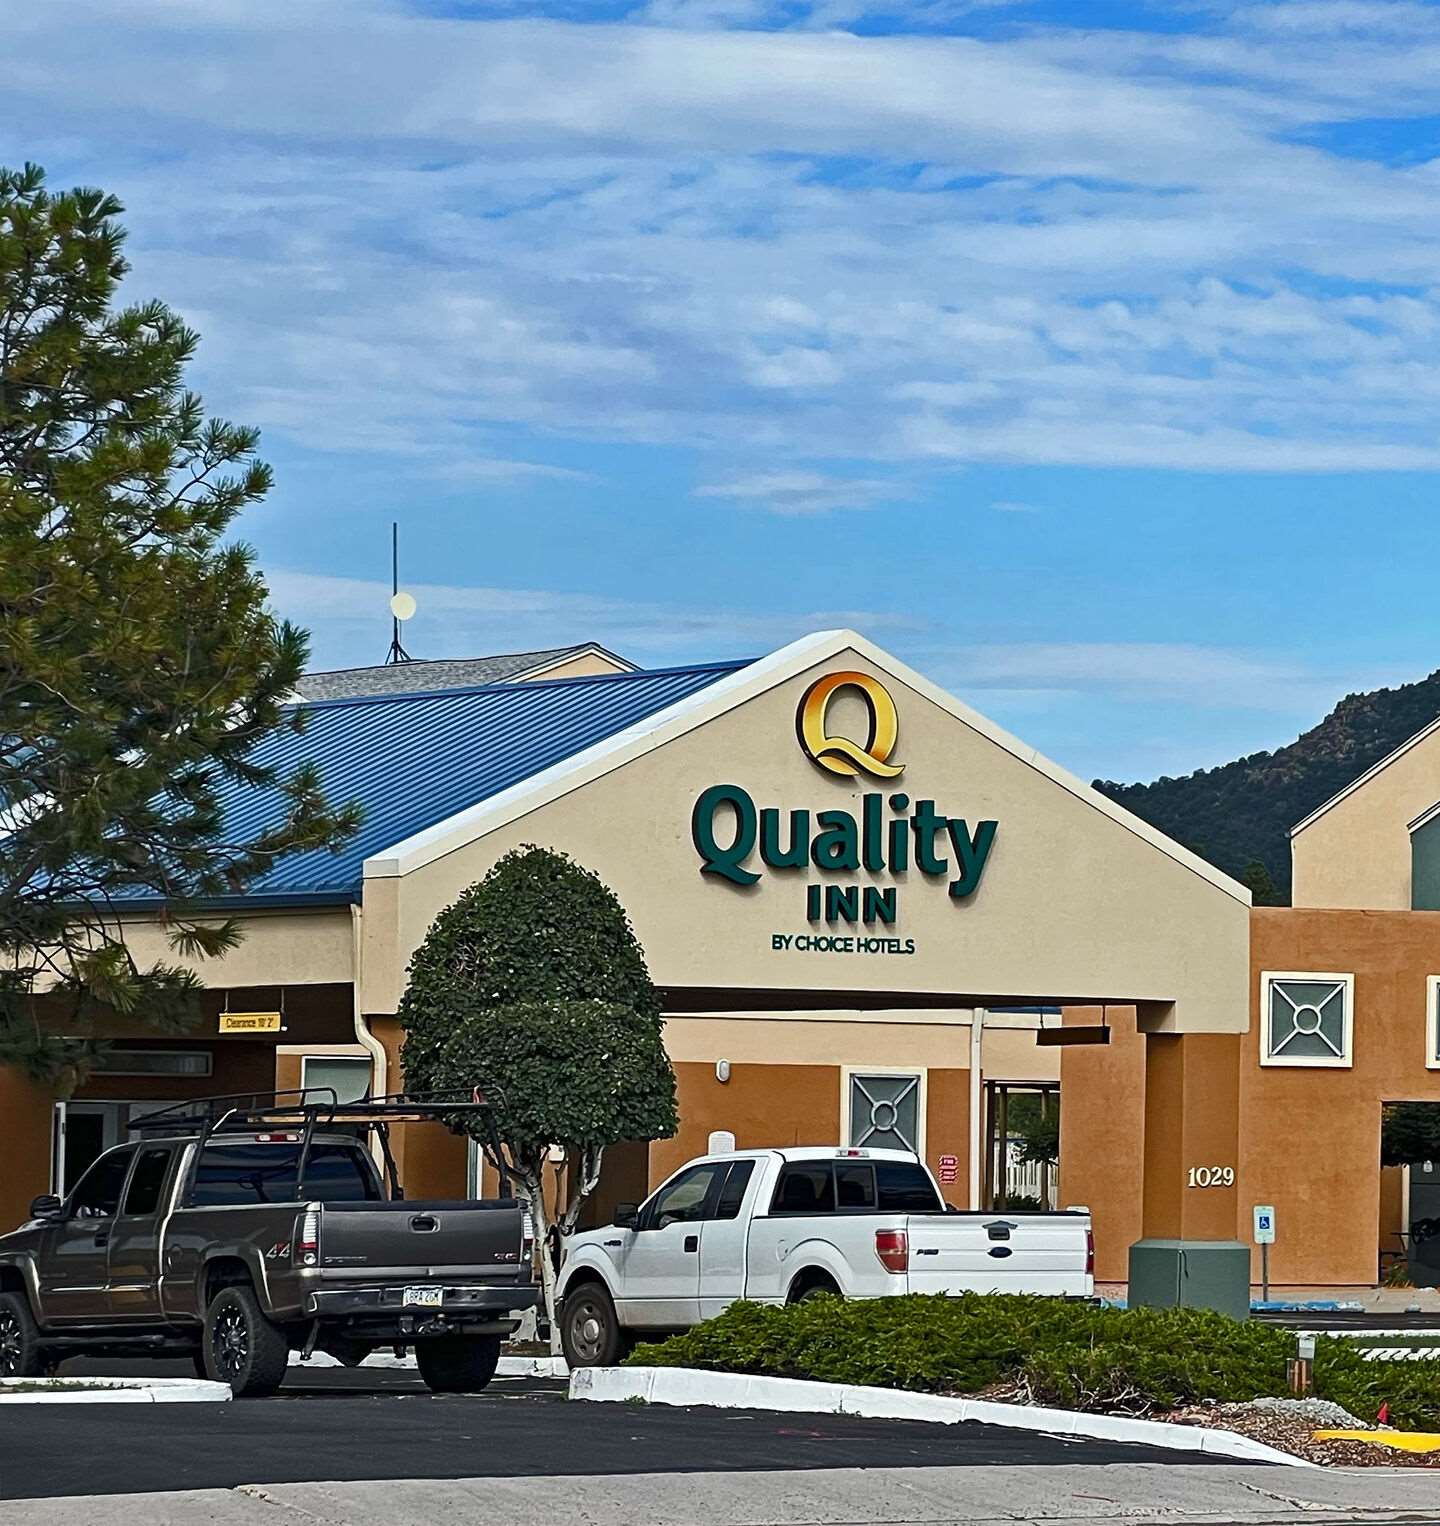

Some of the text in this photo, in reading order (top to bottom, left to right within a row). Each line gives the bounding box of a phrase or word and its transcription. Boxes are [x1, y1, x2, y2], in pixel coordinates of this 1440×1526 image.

[795, 671, 906, 778] Q
[691, 784, 999, 897] Quality
[807, 884, 897, 923] INN
[771, 934, 915, 954] BY CHOICE HOTELS
[1187, 1166, 1235, 1188] 1029
